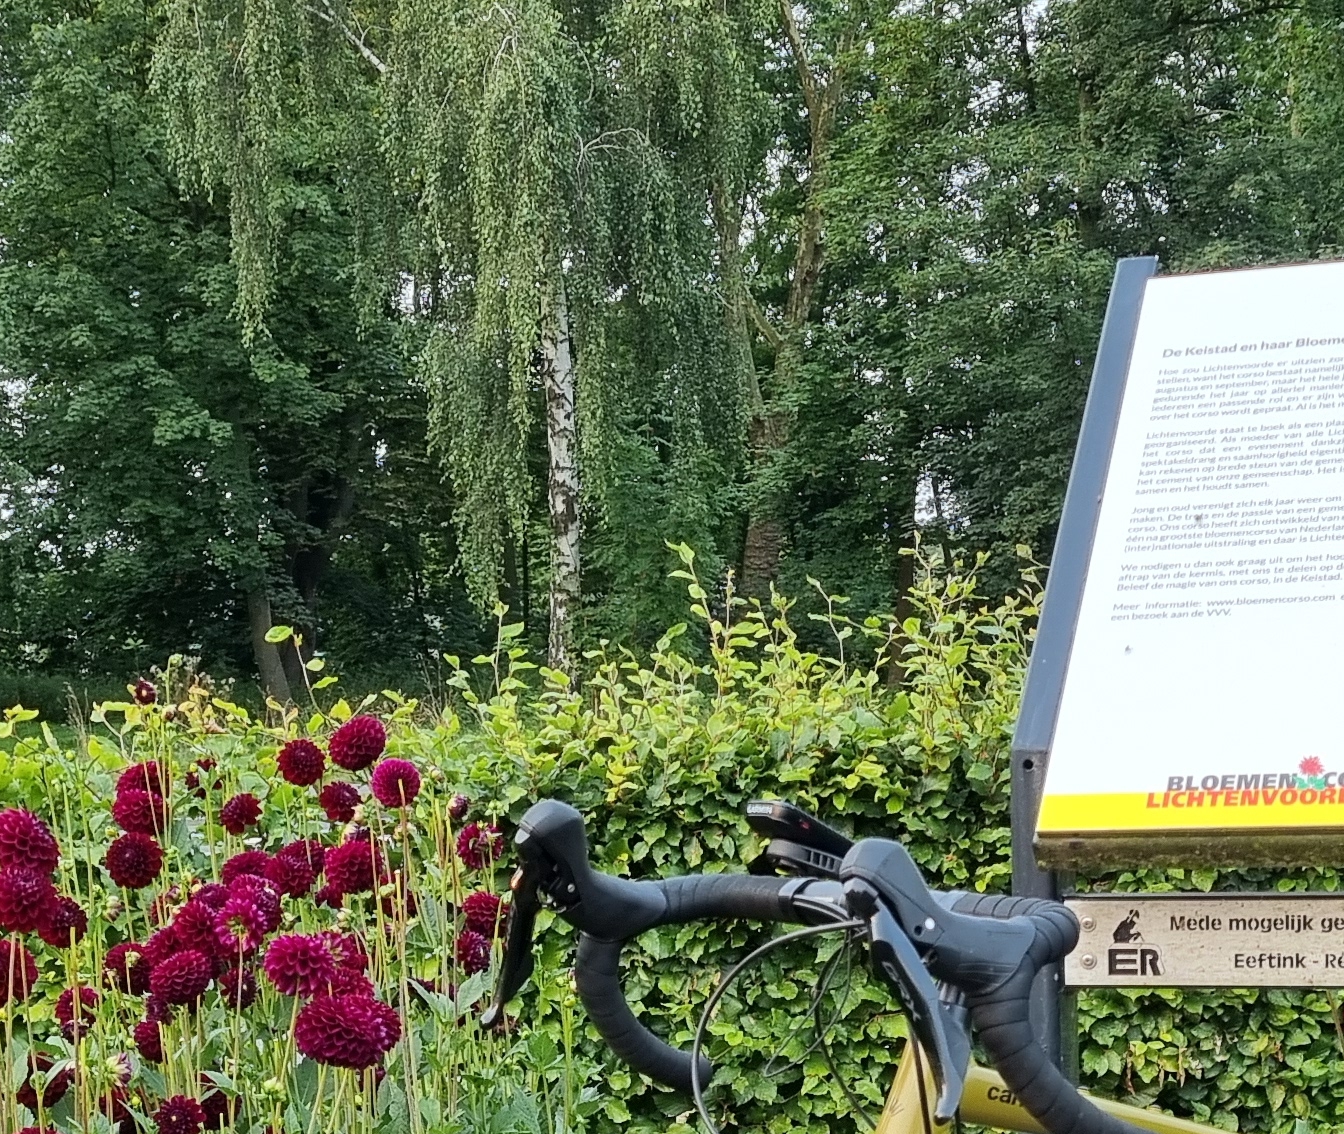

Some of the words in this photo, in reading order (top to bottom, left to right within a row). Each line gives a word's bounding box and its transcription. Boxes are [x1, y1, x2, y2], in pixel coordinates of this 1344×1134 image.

[1162, 347, 1183, 358] De
[1185, 344, 1238, 357] Keistad
[1240, 343, 1258, 352] en
[1260, 340, 1293, 351] haar
[1170, 503, 1190, 512] oud
[1192, 501, 1234, 510] verenigt
[1235, 499, 1256, 508] zich
[1258, 498, 1273, 507] elk
[1274, 498, 1295, 507] jaar
[1226, 510, 1239, 518] de
[1241, 509, 1273, 518] passie
[1159, 523, 1179, 531] Ons
[1181, 521, 1209, 530] corso
[1211, 520, 1237, 528] heeft
[1240, 518, 1260, 527] zich
[1261, 515, 1319, 525] ontwikkeld
[1159, 532, 1202, 542] grootste
[1204, 528, 1277, 538] bloemencorso
[1204, 538, 1257, 548] uitstraling
[1273, 536, 1297, 544] daar
[1299, 535, 1307, 543] is
[1120, 564, 1138, 572] We
[1140, 562, 1181, 571] nodigen
[1193, 560, 1212, 568] dan
[1215, 558, 1234, 567] ook
[1237, 558, 1266, 567] graag
[1269, 556, 1283, 564] uit
[1305, 554, 1323, 562] het
[1118, 573, 1149, 582] aftrap
[1173, 571, 1186, 579] de
[1228, 568, 1249, 576] met
[1274, 566, 1284, 574] te
[1287, 564, 1316, 573] delen
[1319, 564, 1333, 572] op
[1116, 582, 1149, 591] Beleef
[1150, 582, 1164, 590] de
[1165, 580, 1196, 590] magie
[1273, 576, 1283, 584] in
[1284, 575, 1298, 583] de
[1112, 603, 1140, 611] Meer
[1131, 611, 1168, 620] bezoek
[1190, 609, 1204, 618] de
[1166, 773, 1298, 791] BLOEMEN
[1170, 915, 1222, 931] Mede
[1228, 914, 1314, 933] mogelijk
[1108, 948, 1161, 976] ER
[1234, 953, 1307, 968] Eeftink
